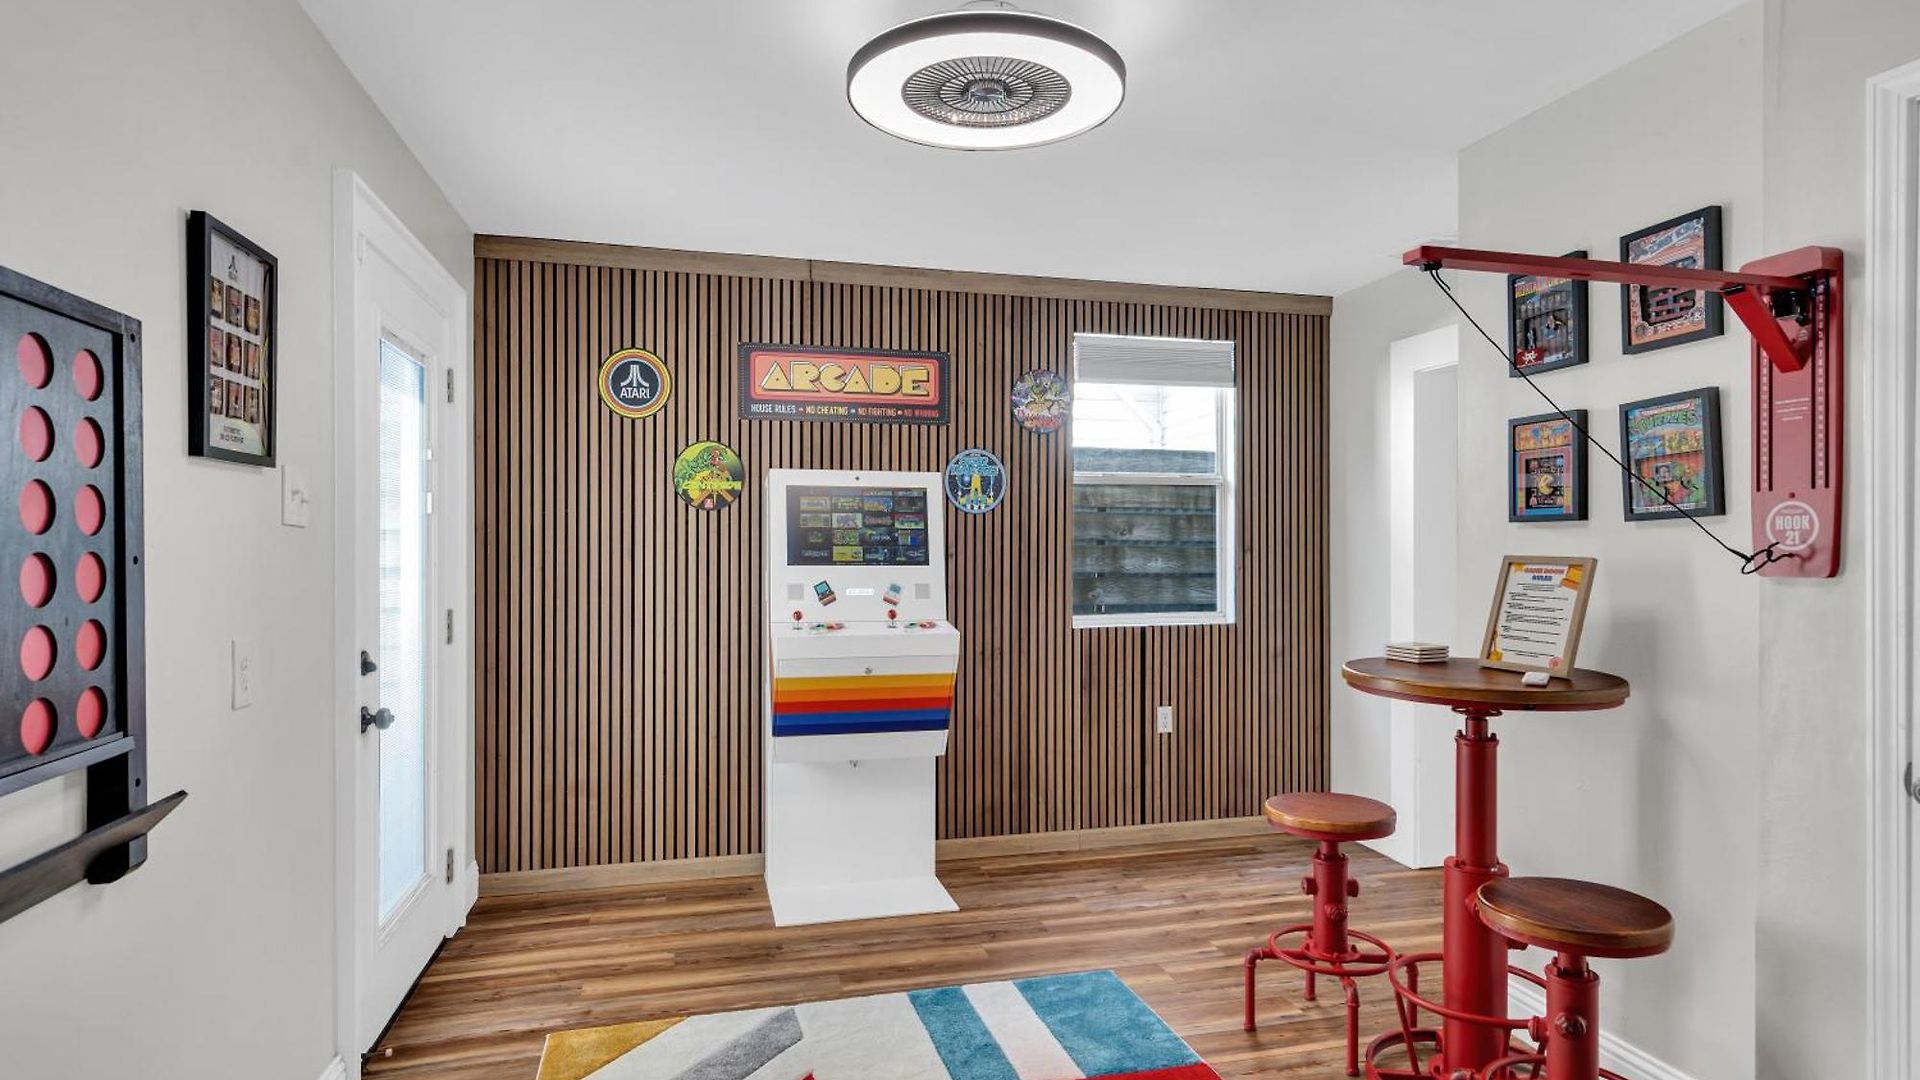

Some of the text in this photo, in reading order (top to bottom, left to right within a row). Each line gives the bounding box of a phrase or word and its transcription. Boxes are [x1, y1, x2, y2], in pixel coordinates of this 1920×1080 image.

[760, 361, 930, 397] ARCADE
[619, 387, 650, 399] ATARI
[751, 404, 773, 413] HOUSE
[774, 404, 796, 414] RULES
[805, 405, 816, 415] NO
[817, 405, 849, 416] CHEATING
[858, 407, 867, 416] NO
[867, 407, 897, 417] FIGHTING
[1775, 514, 1810, 530] HOOK
[1784, 530, 1799, 545] 21
